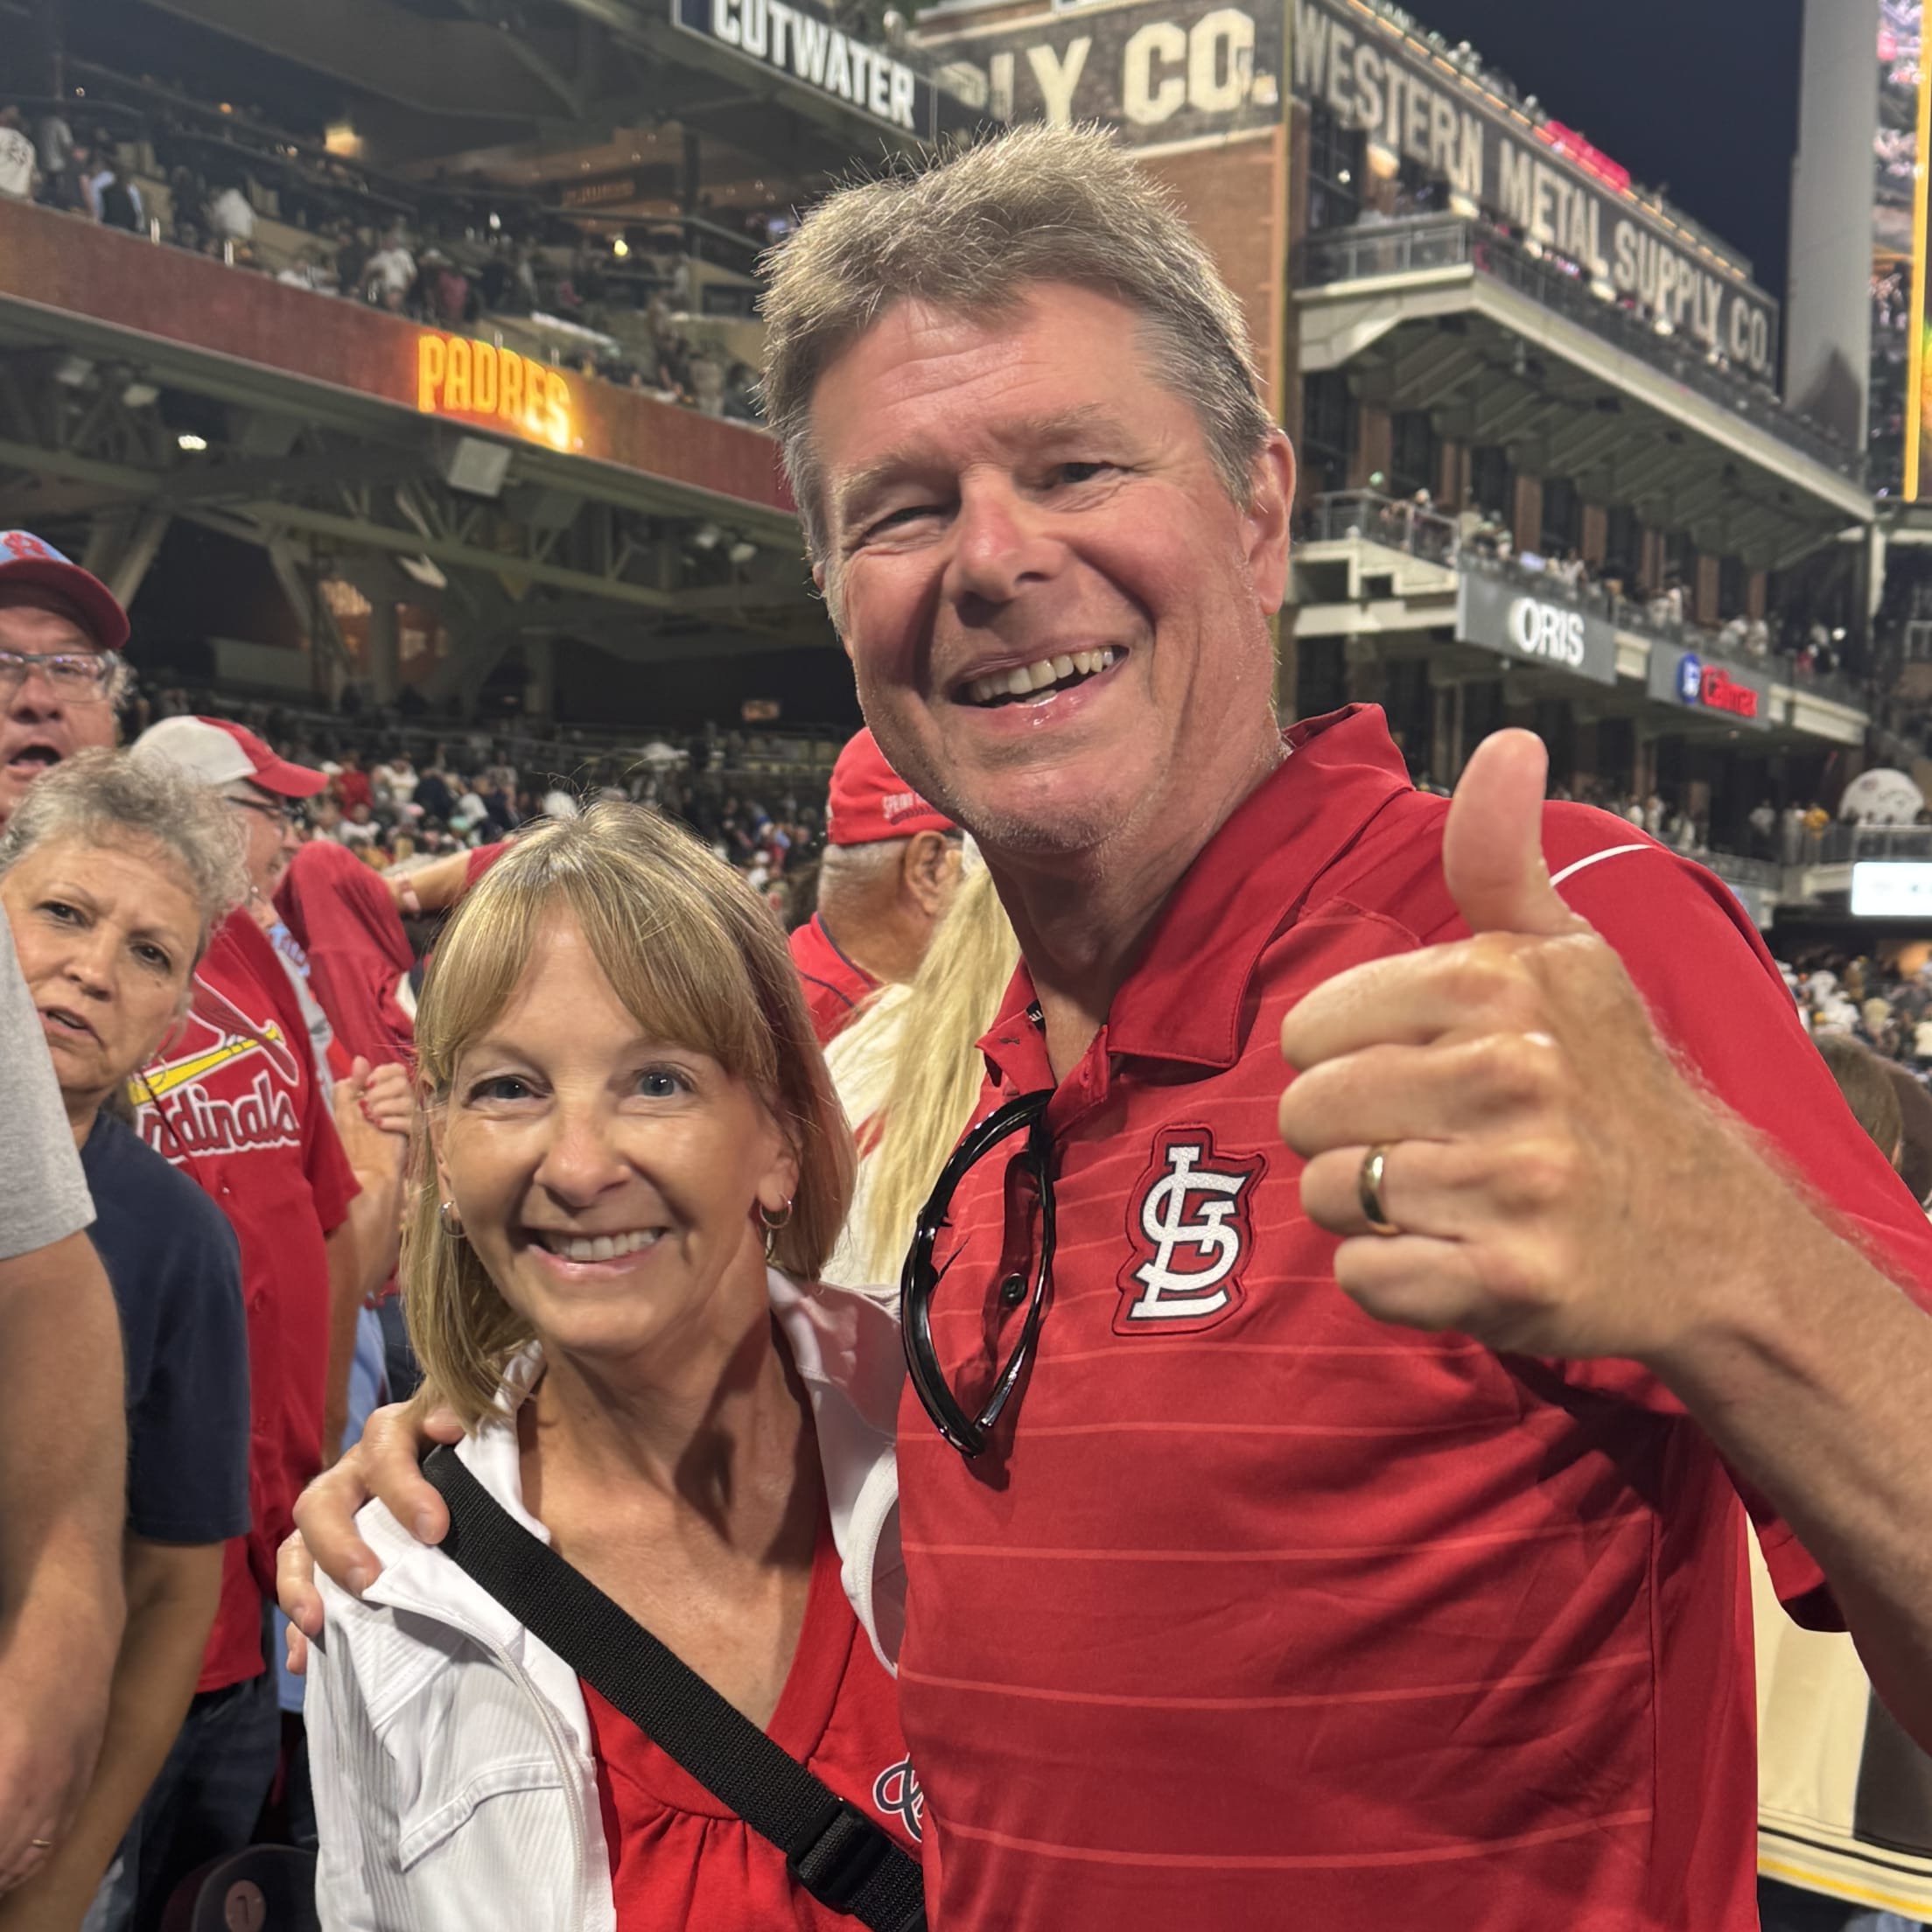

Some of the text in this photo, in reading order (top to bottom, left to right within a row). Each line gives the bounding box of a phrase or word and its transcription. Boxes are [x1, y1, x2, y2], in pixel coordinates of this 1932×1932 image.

[713, 0, 914, 129] CUTWATER
[1294, 0, 1484, 197] WESTERN
[1499, 137, 1608, 278] METAL
[1614, 220, 1724, 346] SUPPLY
[418, 335, 570, 452] PADRES
[1512, 597, 1586, 667] ORIS
[136, 1069, 301, 1164] rdinals
